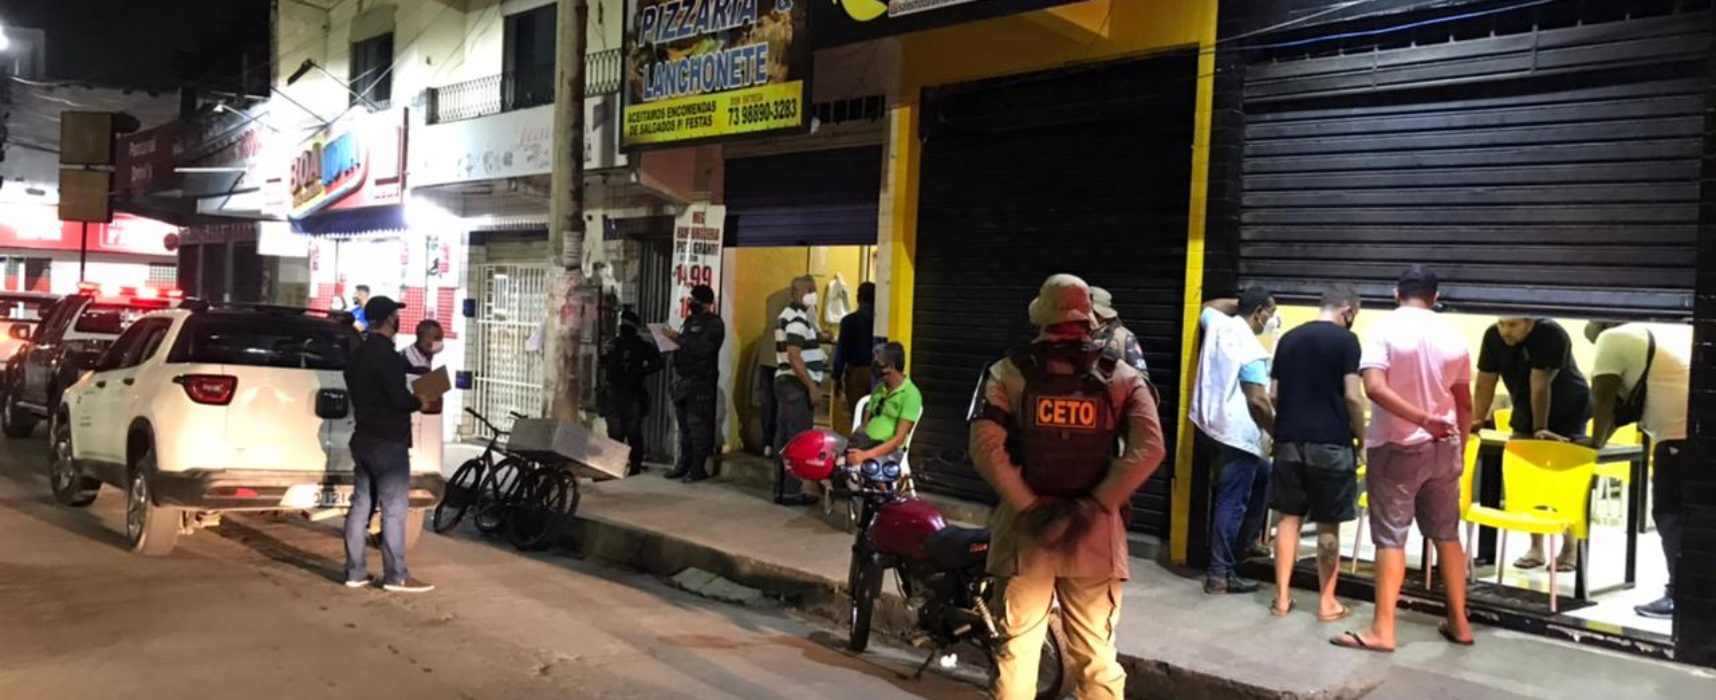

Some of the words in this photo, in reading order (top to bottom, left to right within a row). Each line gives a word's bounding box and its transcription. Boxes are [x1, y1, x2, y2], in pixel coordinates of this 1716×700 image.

[638, 0, 757, 47] PIZZARIA
[643, 41, 769, 101] LANCHONETE
[628, 106, 665, 123] ACEITAMOS
[667, 101, 716, 118] ENCOMENDAS
[728, 107, 740, 126] 73
[629, 124, 638, 136] DE
[639, 120, 675, 135] SALGADOS
[685, 115, 712, 129] FESTAS
[1040, 399, 1094, 425] CETO
